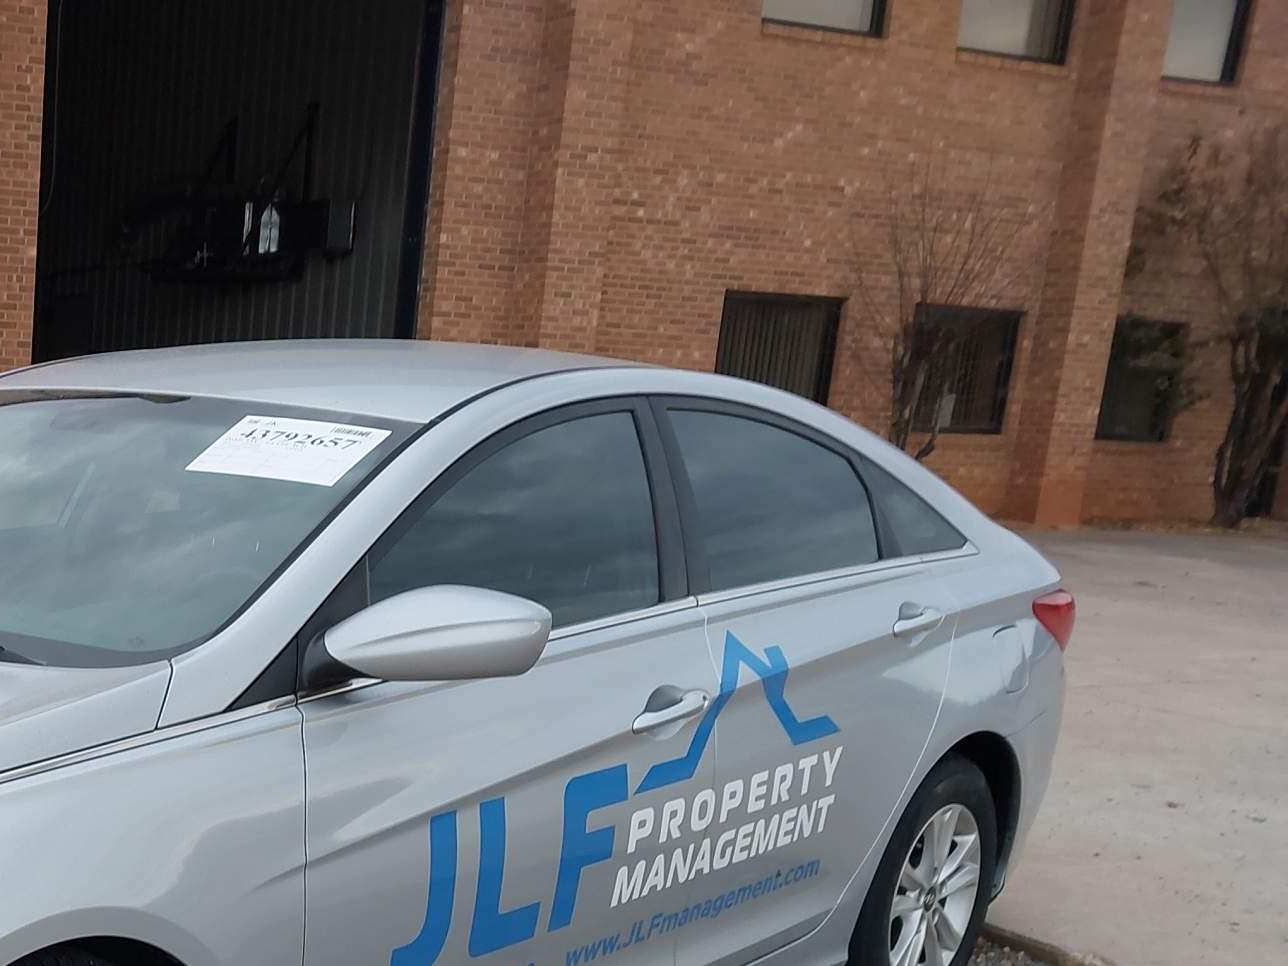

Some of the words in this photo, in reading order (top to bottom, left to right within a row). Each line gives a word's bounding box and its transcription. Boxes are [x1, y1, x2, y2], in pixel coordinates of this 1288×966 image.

[240, 428, 358, 450] 43792657
[609, 795, 836, 908] MANAGEMENT
[626, 745, 844, 854] PROPERTY
